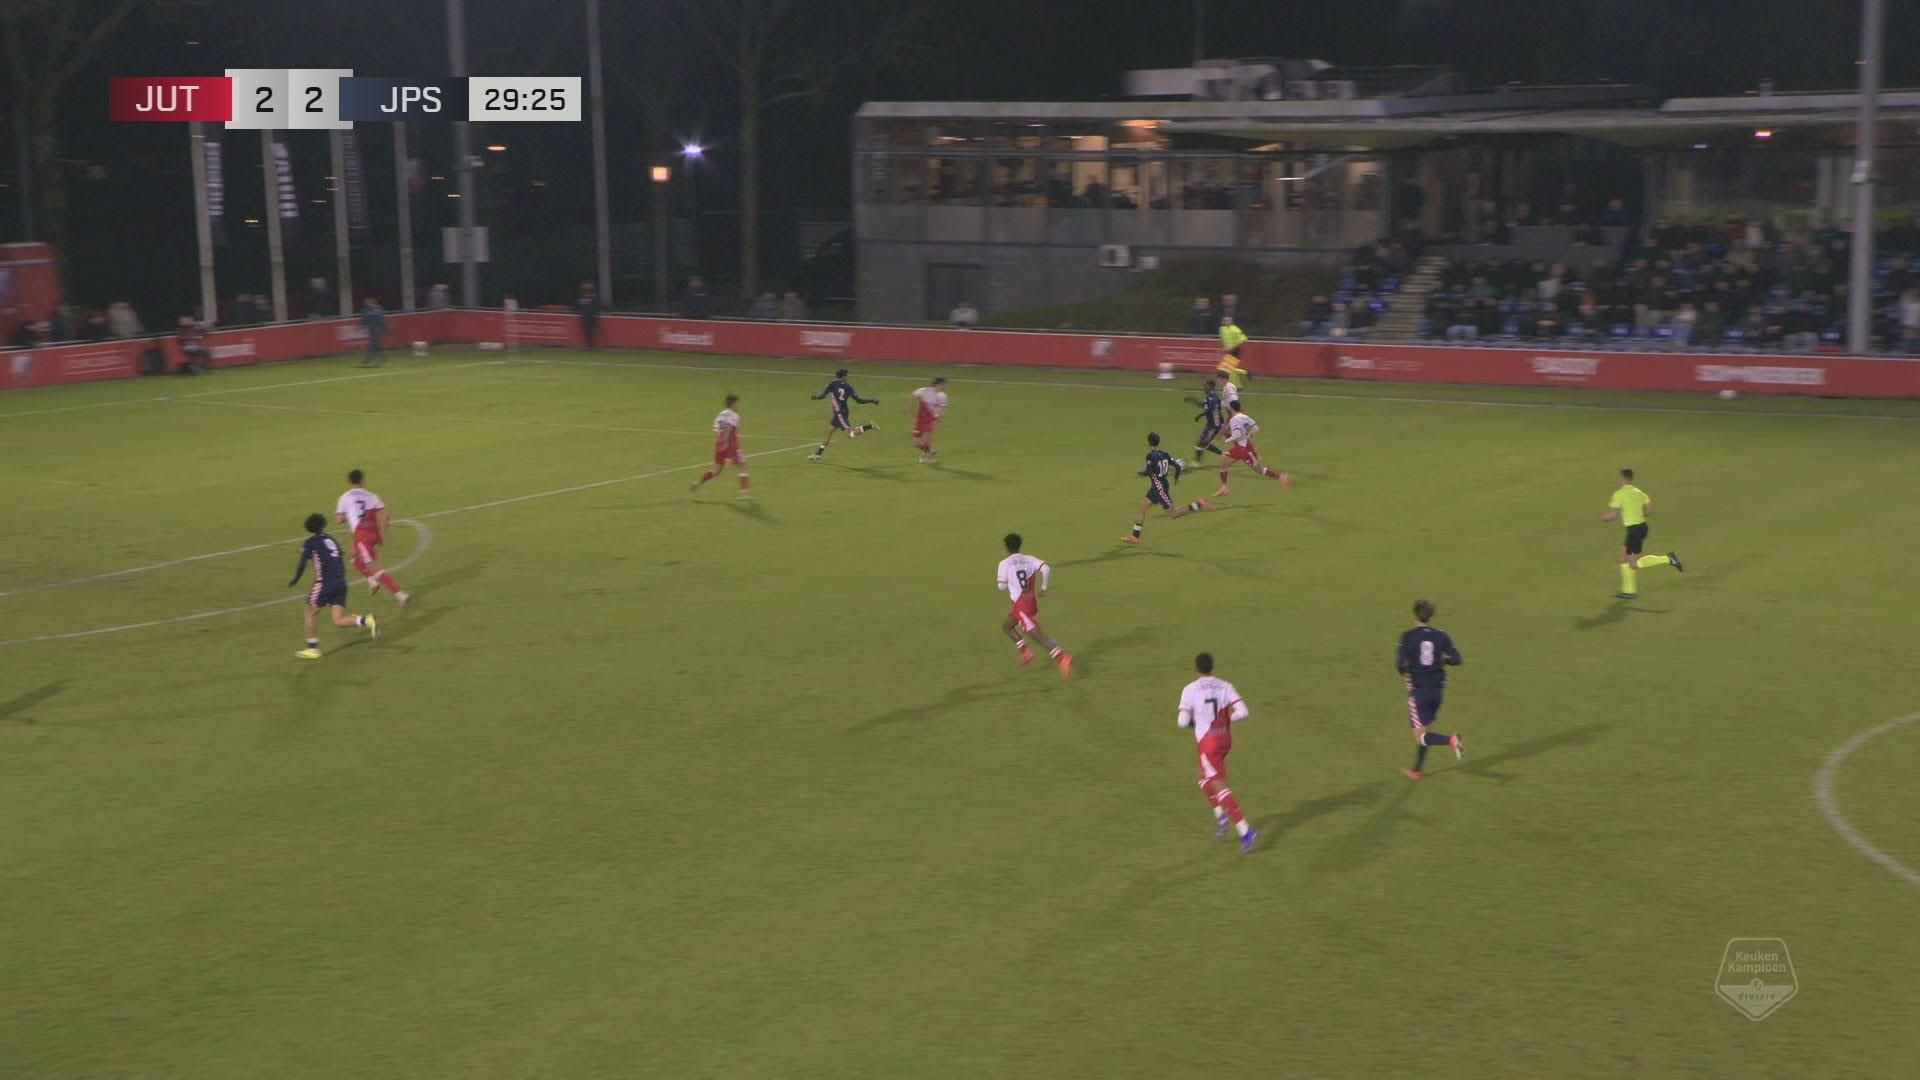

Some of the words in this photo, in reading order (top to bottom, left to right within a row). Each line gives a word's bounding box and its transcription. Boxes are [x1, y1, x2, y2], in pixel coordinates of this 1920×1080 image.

[838, 387, 846, 401] 2
[1158, 459, 1169, 478] 10
[324, 538, 340, 557] 9
[1016, 569, 1028, 590] 8
[1420, 640, 1434, 666] 8
[1204, 698, 1218, 721] 7
